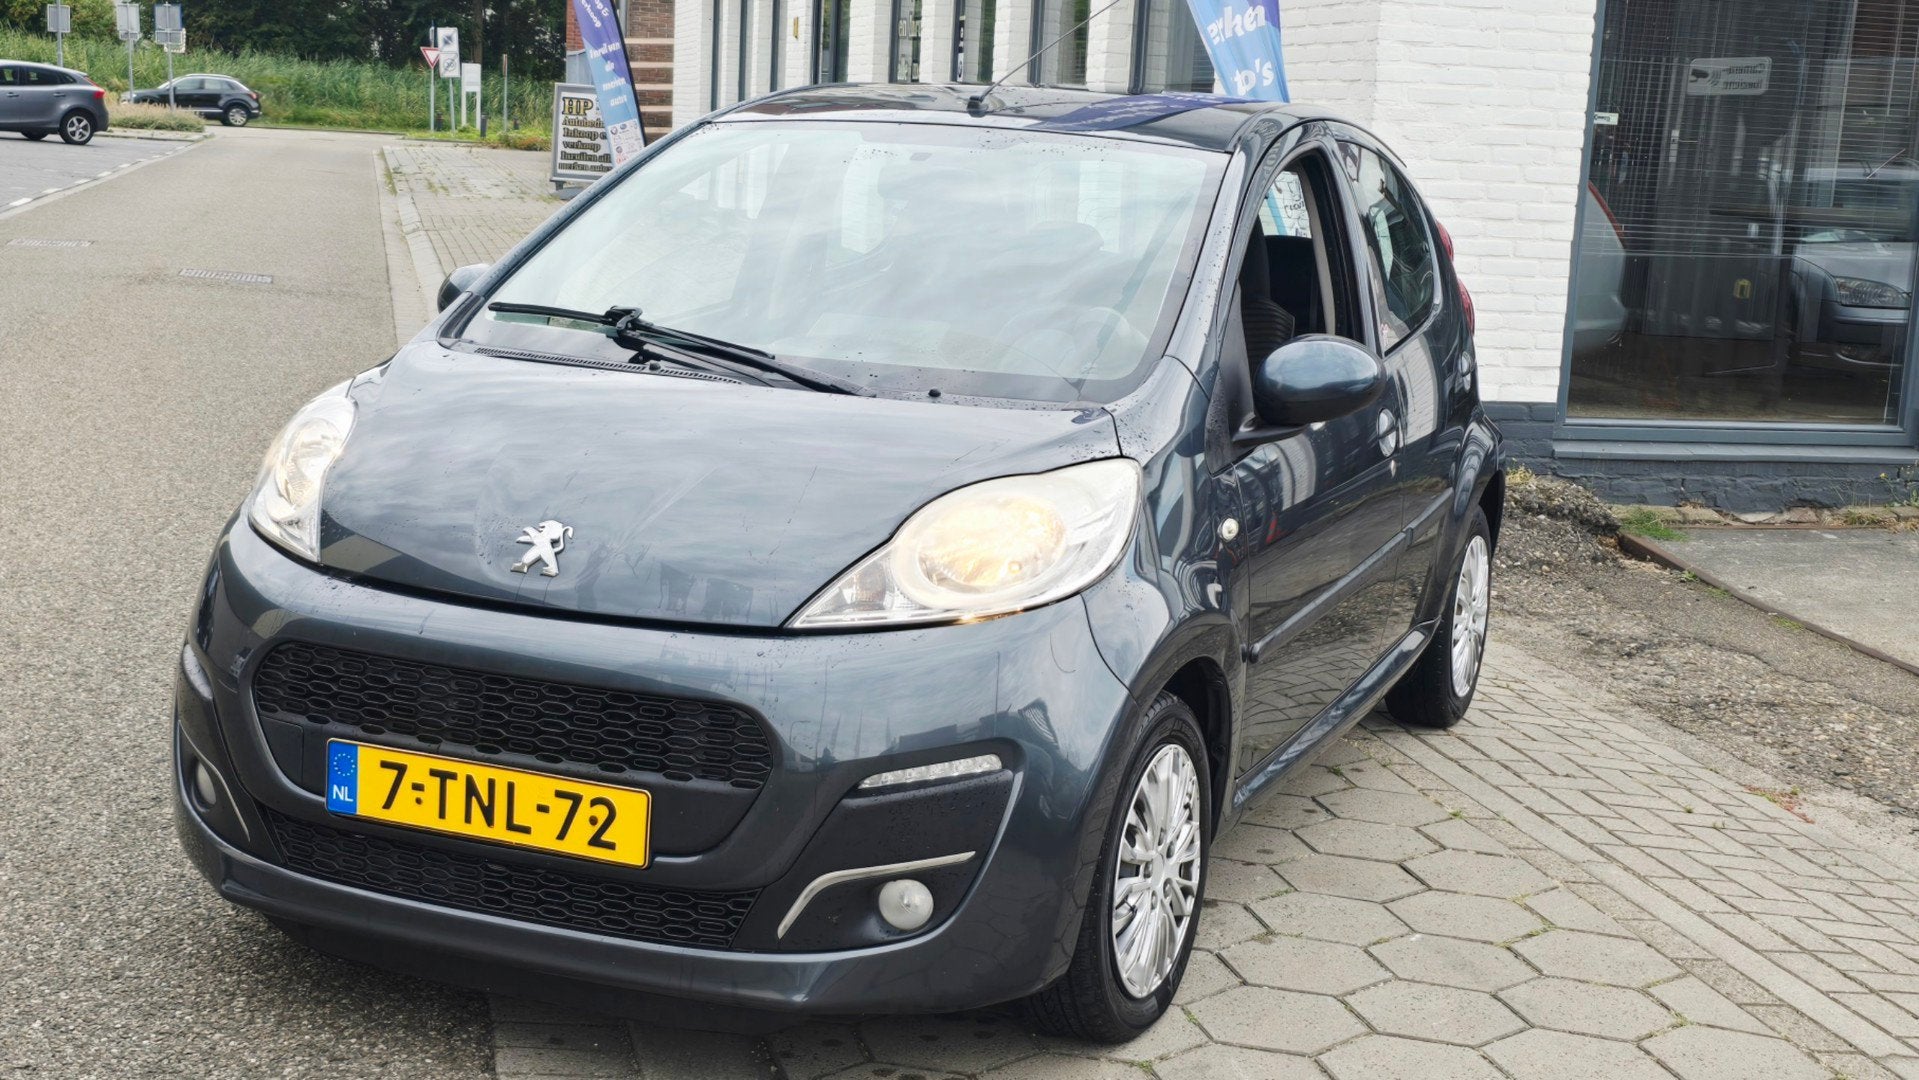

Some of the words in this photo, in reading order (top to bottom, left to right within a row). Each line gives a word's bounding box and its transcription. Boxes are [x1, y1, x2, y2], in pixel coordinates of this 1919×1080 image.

[581, 0, 602, 27] erkoop
[1207, 5, 1265, 45] erken
[1234, 58, 1275, 96] to's
[562, 97, 594, 115] HP
[563, 128, 599, 141] Inkoop
[563, 141, 601, 153] verkoop
[558, 162, 589, 171] merken
[332, 784, 354, 803] NL
[379, 760, 617, 850] 7-TNL-72
